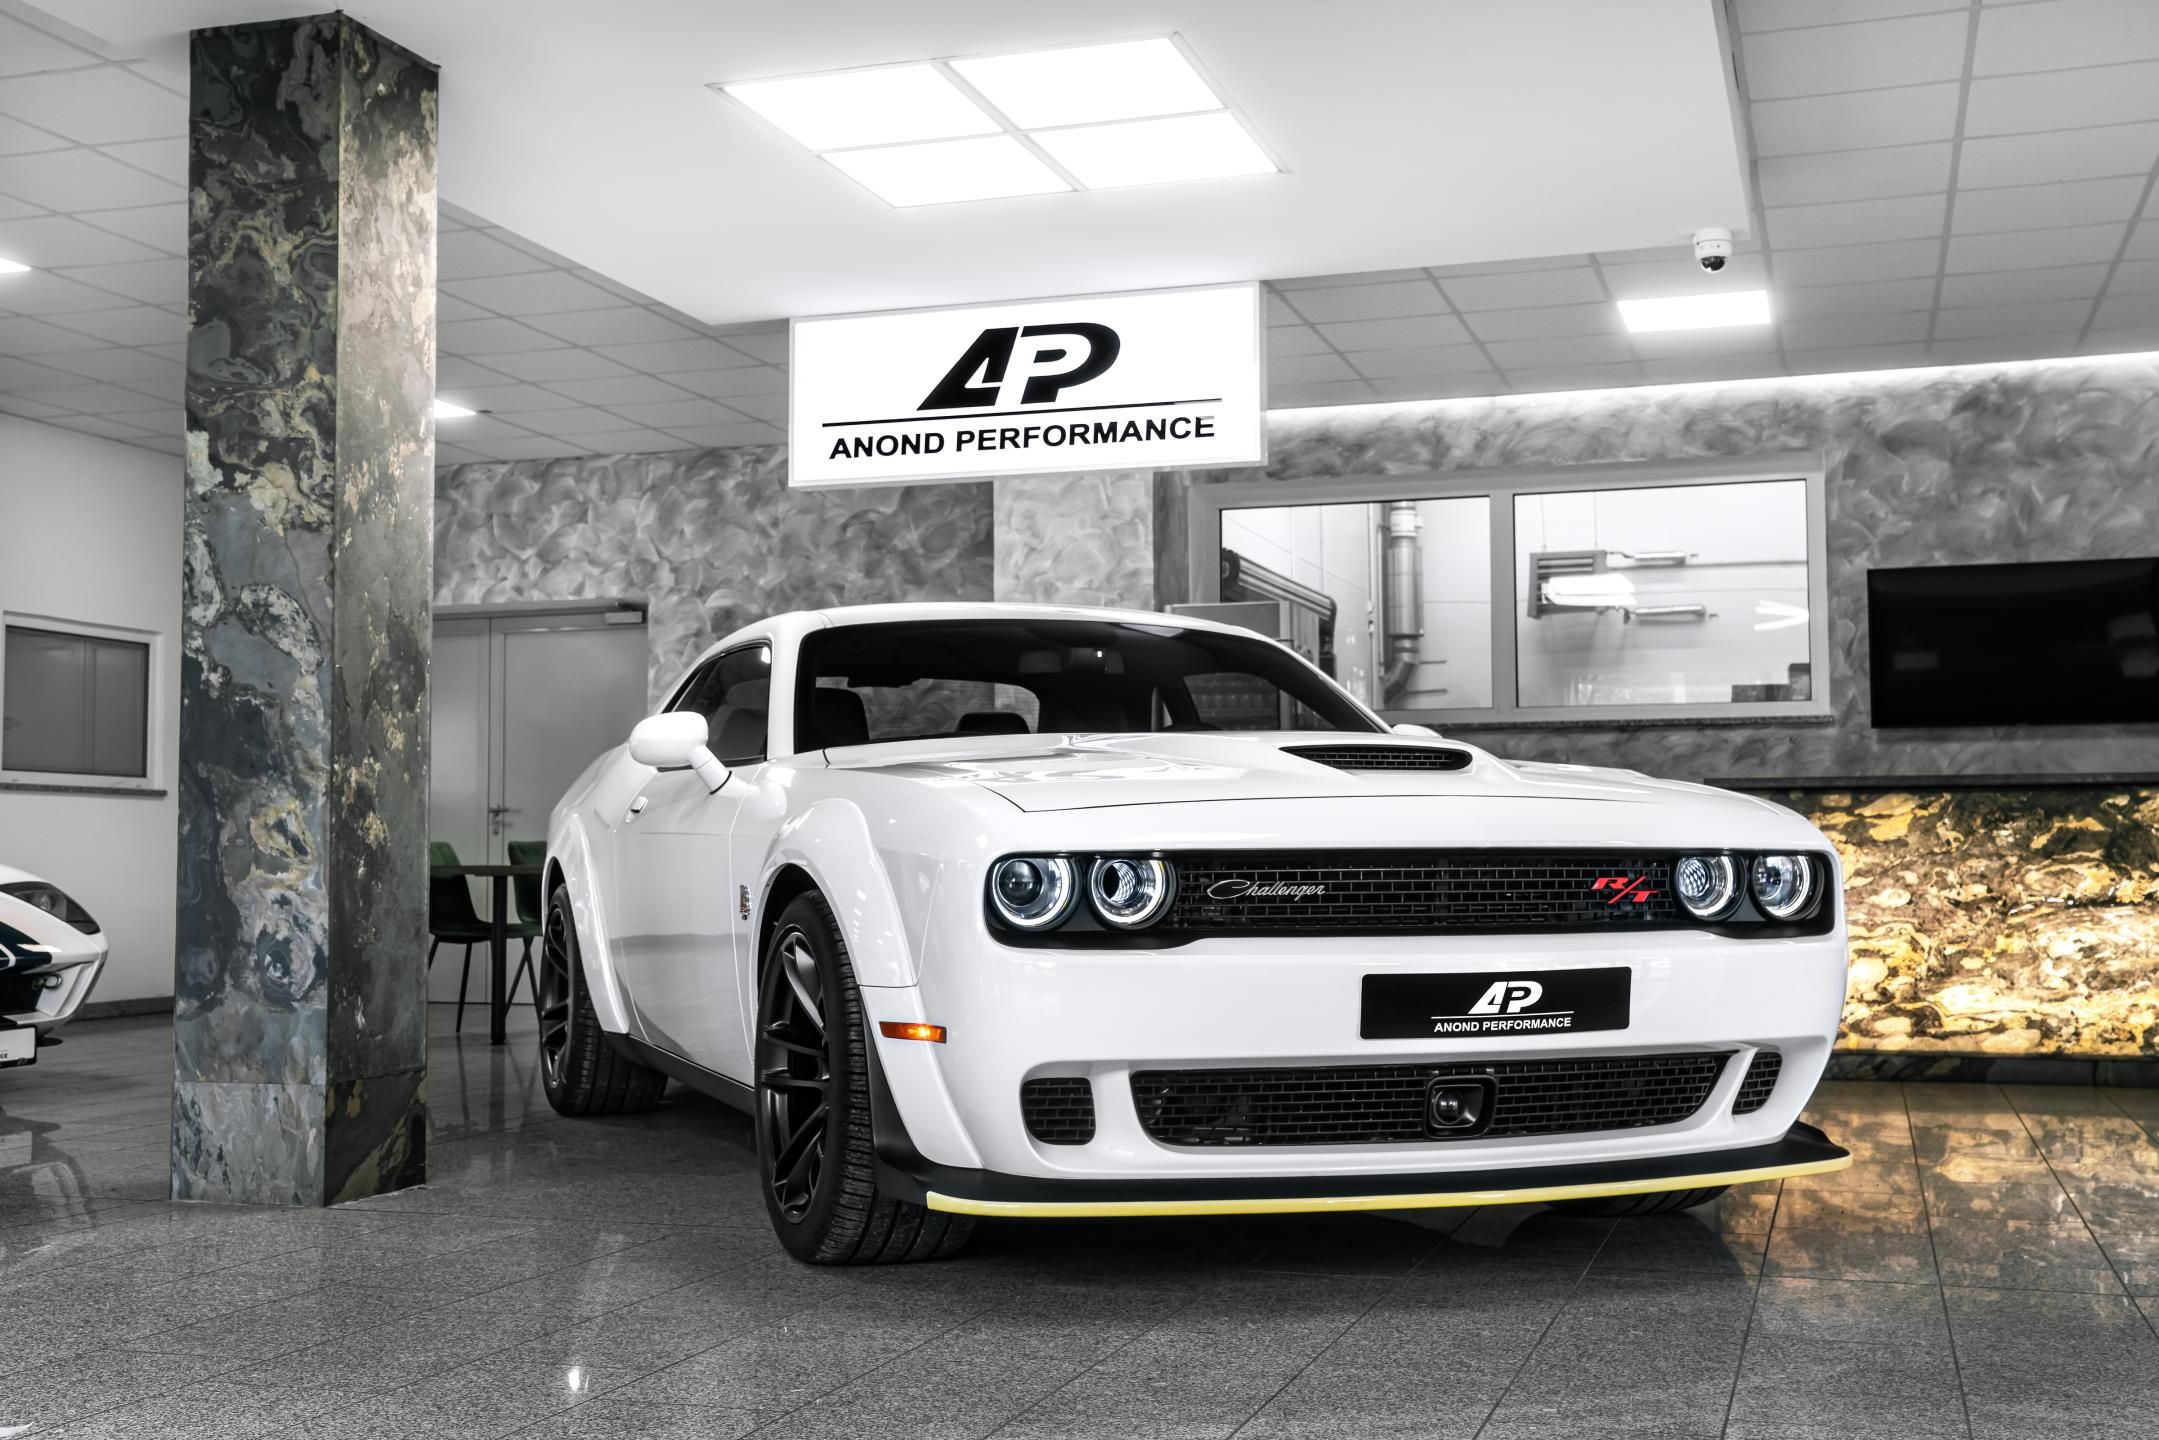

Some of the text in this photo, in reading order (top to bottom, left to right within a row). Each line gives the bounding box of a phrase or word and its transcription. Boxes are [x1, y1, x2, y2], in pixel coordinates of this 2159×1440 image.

[916, 322, 1121, 411] AP
[829, 416, 1215, 460] ANOND PERFORMANCE
[1206, 879, 1326, 902] Challenger
[1591, 875, 1659, 905] R/T
[1467, 980, 1543, 1015] AP
[1433, 1016, 1572, 1033] ANOND PERFORMANCE
